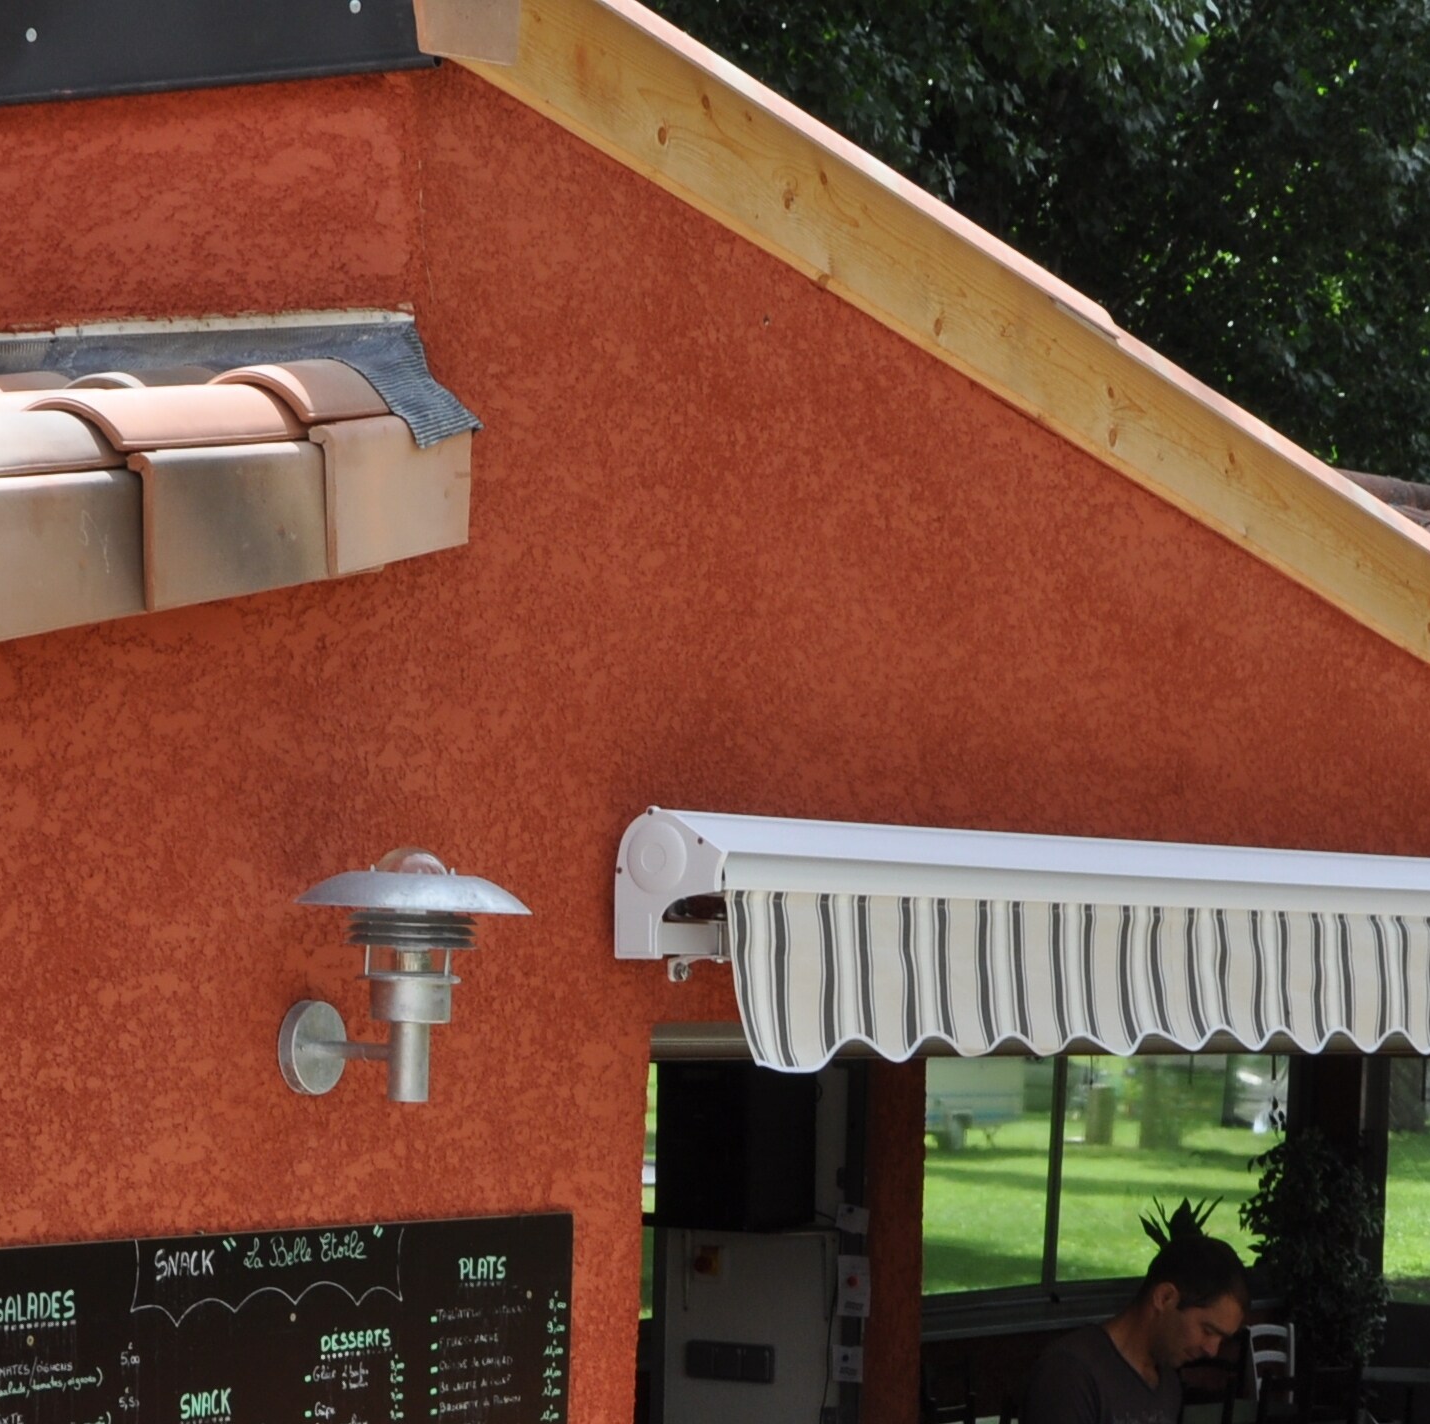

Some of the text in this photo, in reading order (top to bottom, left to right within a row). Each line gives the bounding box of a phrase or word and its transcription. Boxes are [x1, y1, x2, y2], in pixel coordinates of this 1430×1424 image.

[154, 1230, 367, 1281] SNACK La Belle Etoile
[458, 1255, 507, 1280] PLATS
[180, 1387, 231, 1420] SNACK
